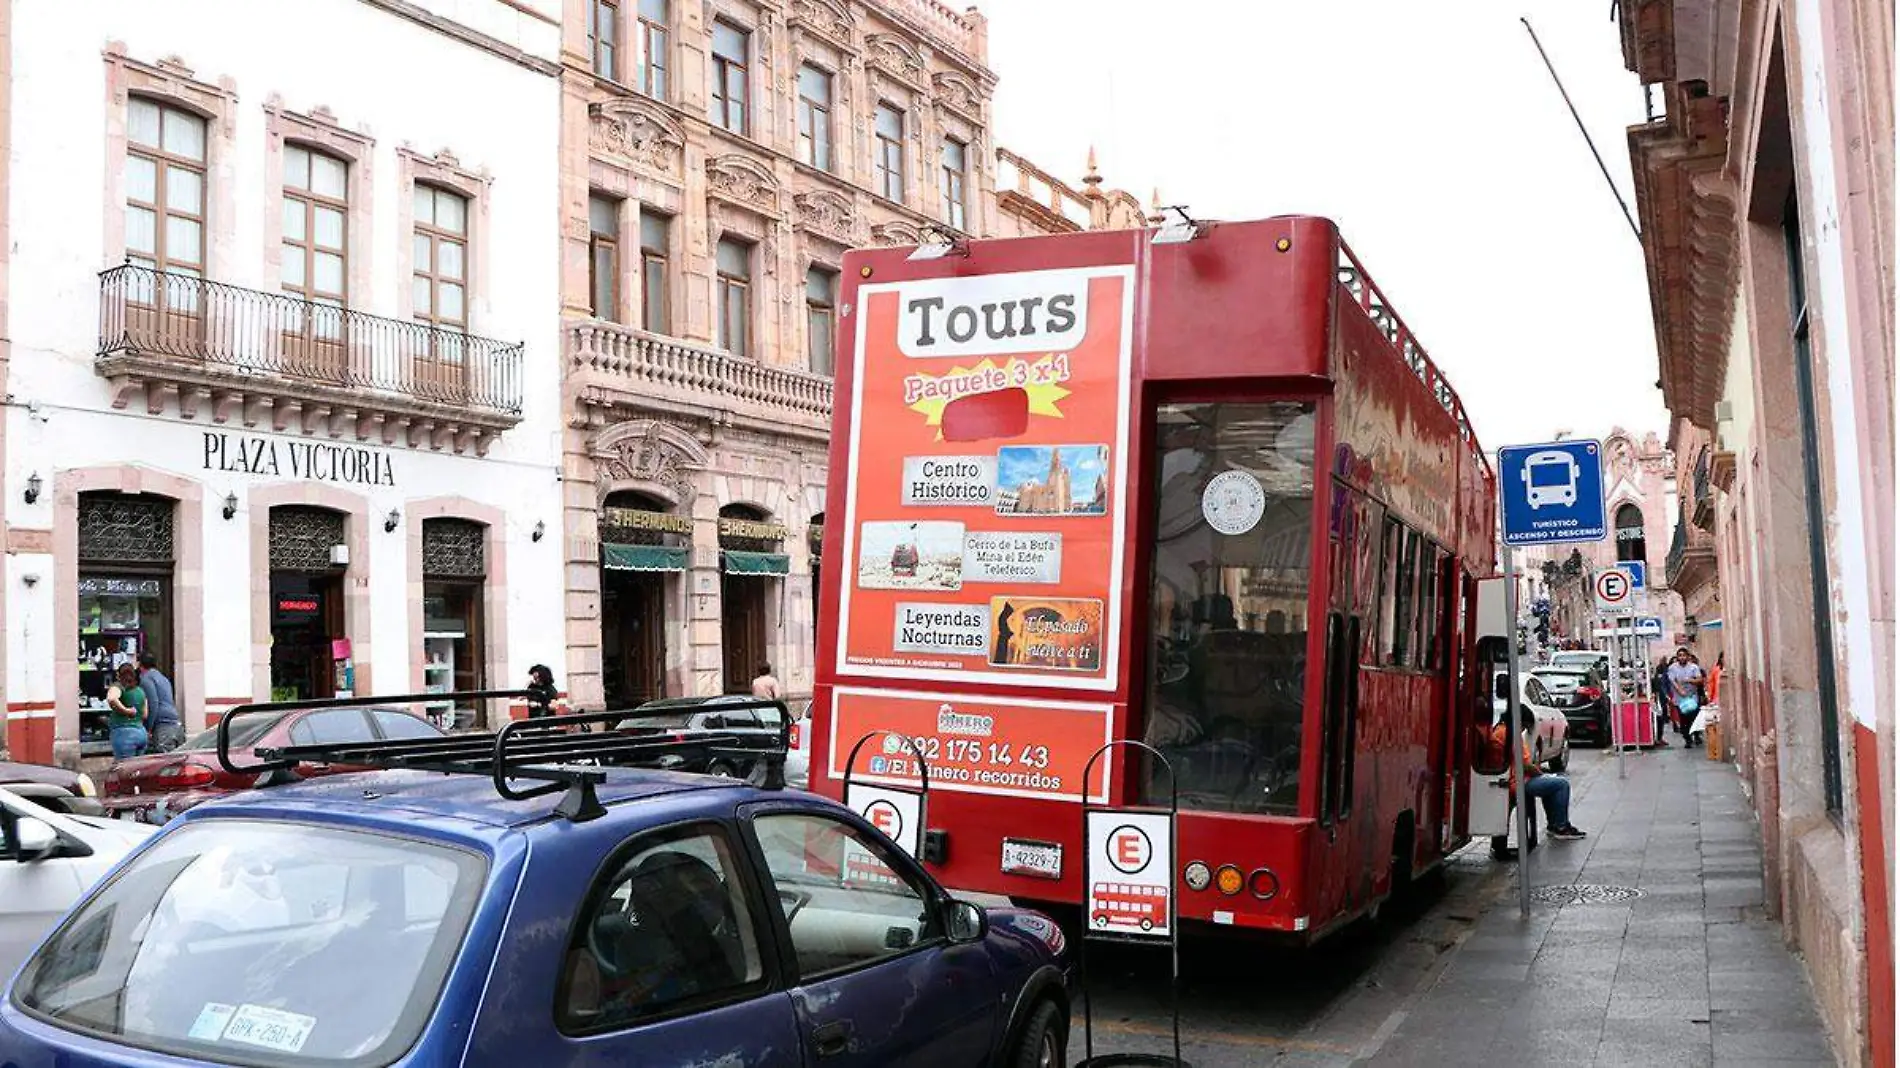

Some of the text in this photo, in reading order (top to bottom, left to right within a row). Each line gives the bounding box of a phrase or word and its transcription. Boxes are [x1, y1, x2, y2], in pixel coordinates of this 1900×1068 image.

[908, 294, 1077, 347] Tours
[905, 368, 1008, 402] Paquete
[1012, 361, 1029, 386] 3
[202, 431, 396, 487] PLAZA VICTORIA
[922, 460, 979, 478] Centro
[911, 481, 988, 499] Histórico
[622, 510, 694, 534] HERMANOS
[1531, 518, 1578, 529] TURÍSTICO
[1508, 527, 1604, 541] ASCENSO Y DESCENSO
[967, 538, 1055, 552] Cerro de La Bufa
[977, 551, 1044, 563] Mina el Edén
[984, 563, 1036, 576] Teleférico
[1605, 577, 1621, 597] E
[905, 608, 981, 629] Leyendas
[1045, 617, 1090, 635] pasado
[901, 627, 984, 647] Nocturnas
[1027, 643, 1091, 659] vuelve a ti
[899, 736, 1050, 769] 492 175 14 43
[973, 768, 1061, 789] recorridos
[1117, 834, 1142, 865] E
